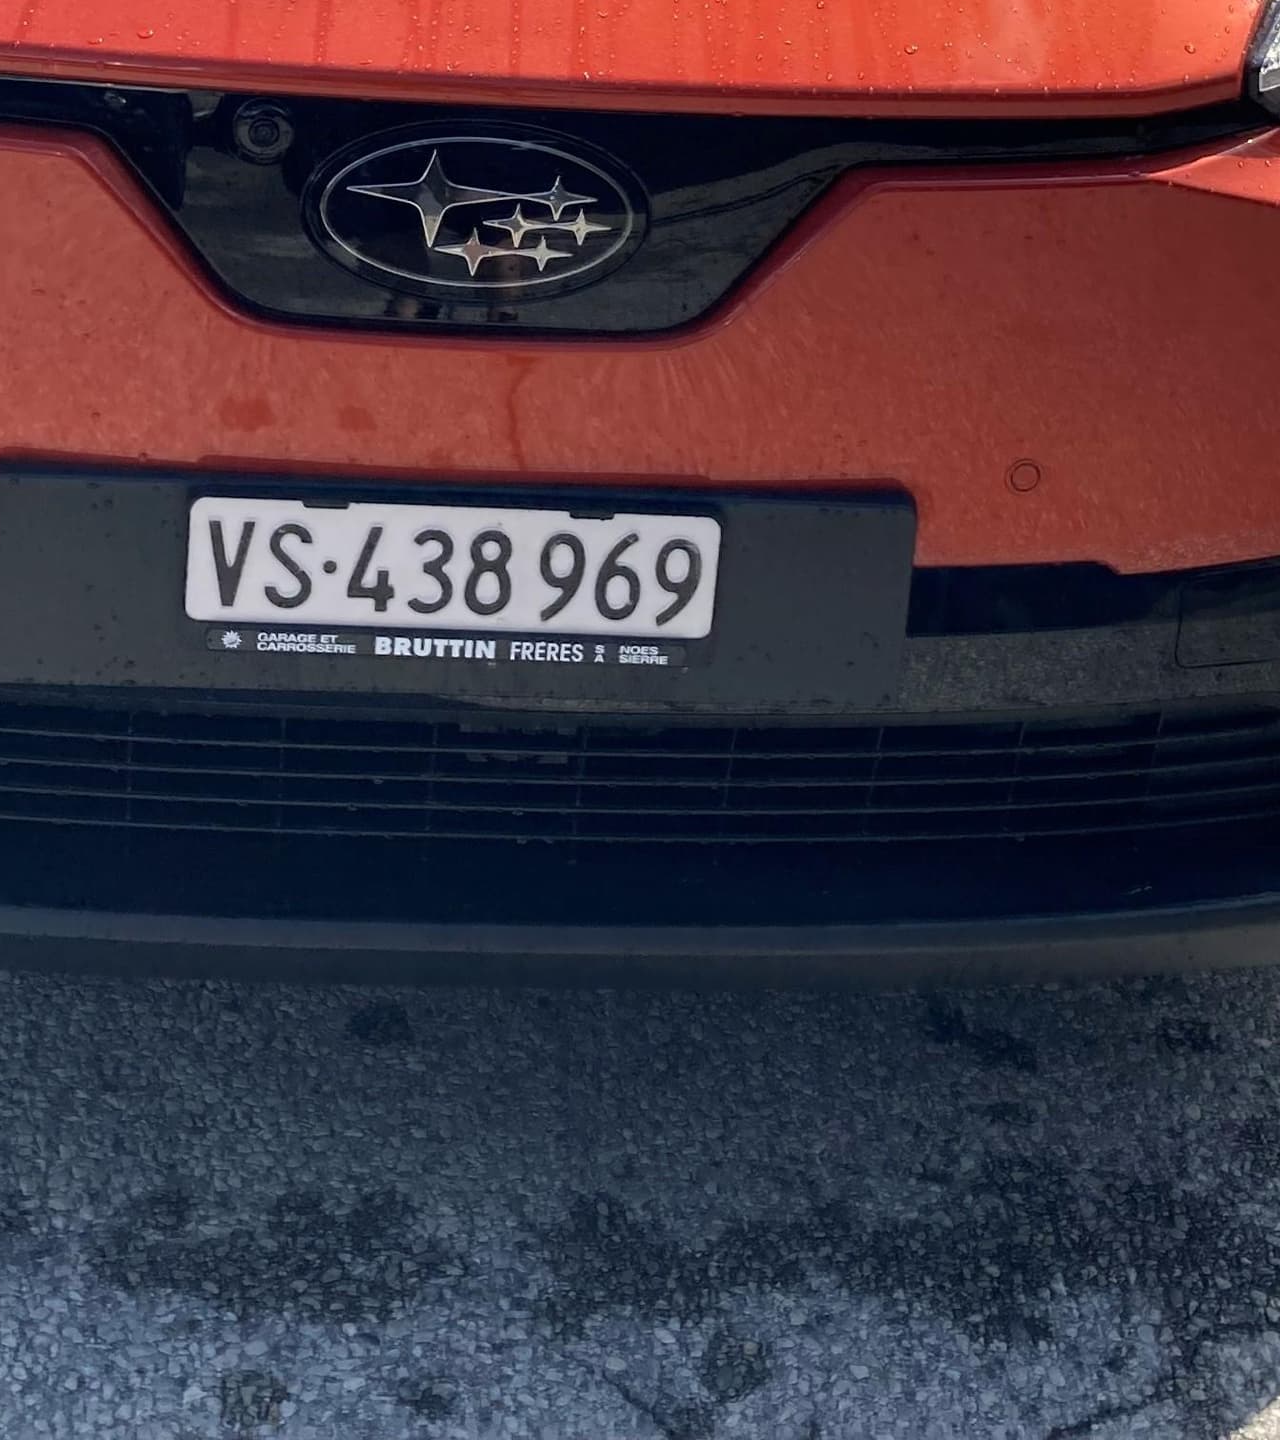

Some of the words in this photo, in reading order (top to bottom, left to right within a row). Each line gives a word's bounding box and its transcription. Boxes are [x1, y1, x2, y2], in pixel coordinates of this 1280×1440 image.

[257, 632, 317, 643] GARAGE
[320, 634, 338, 644] ET
[256, 642, 356, 654] CARROSSERIE
[374, 636, 496, 660] BRUTTIN
[618, 654, 669, 665] SIERRE
